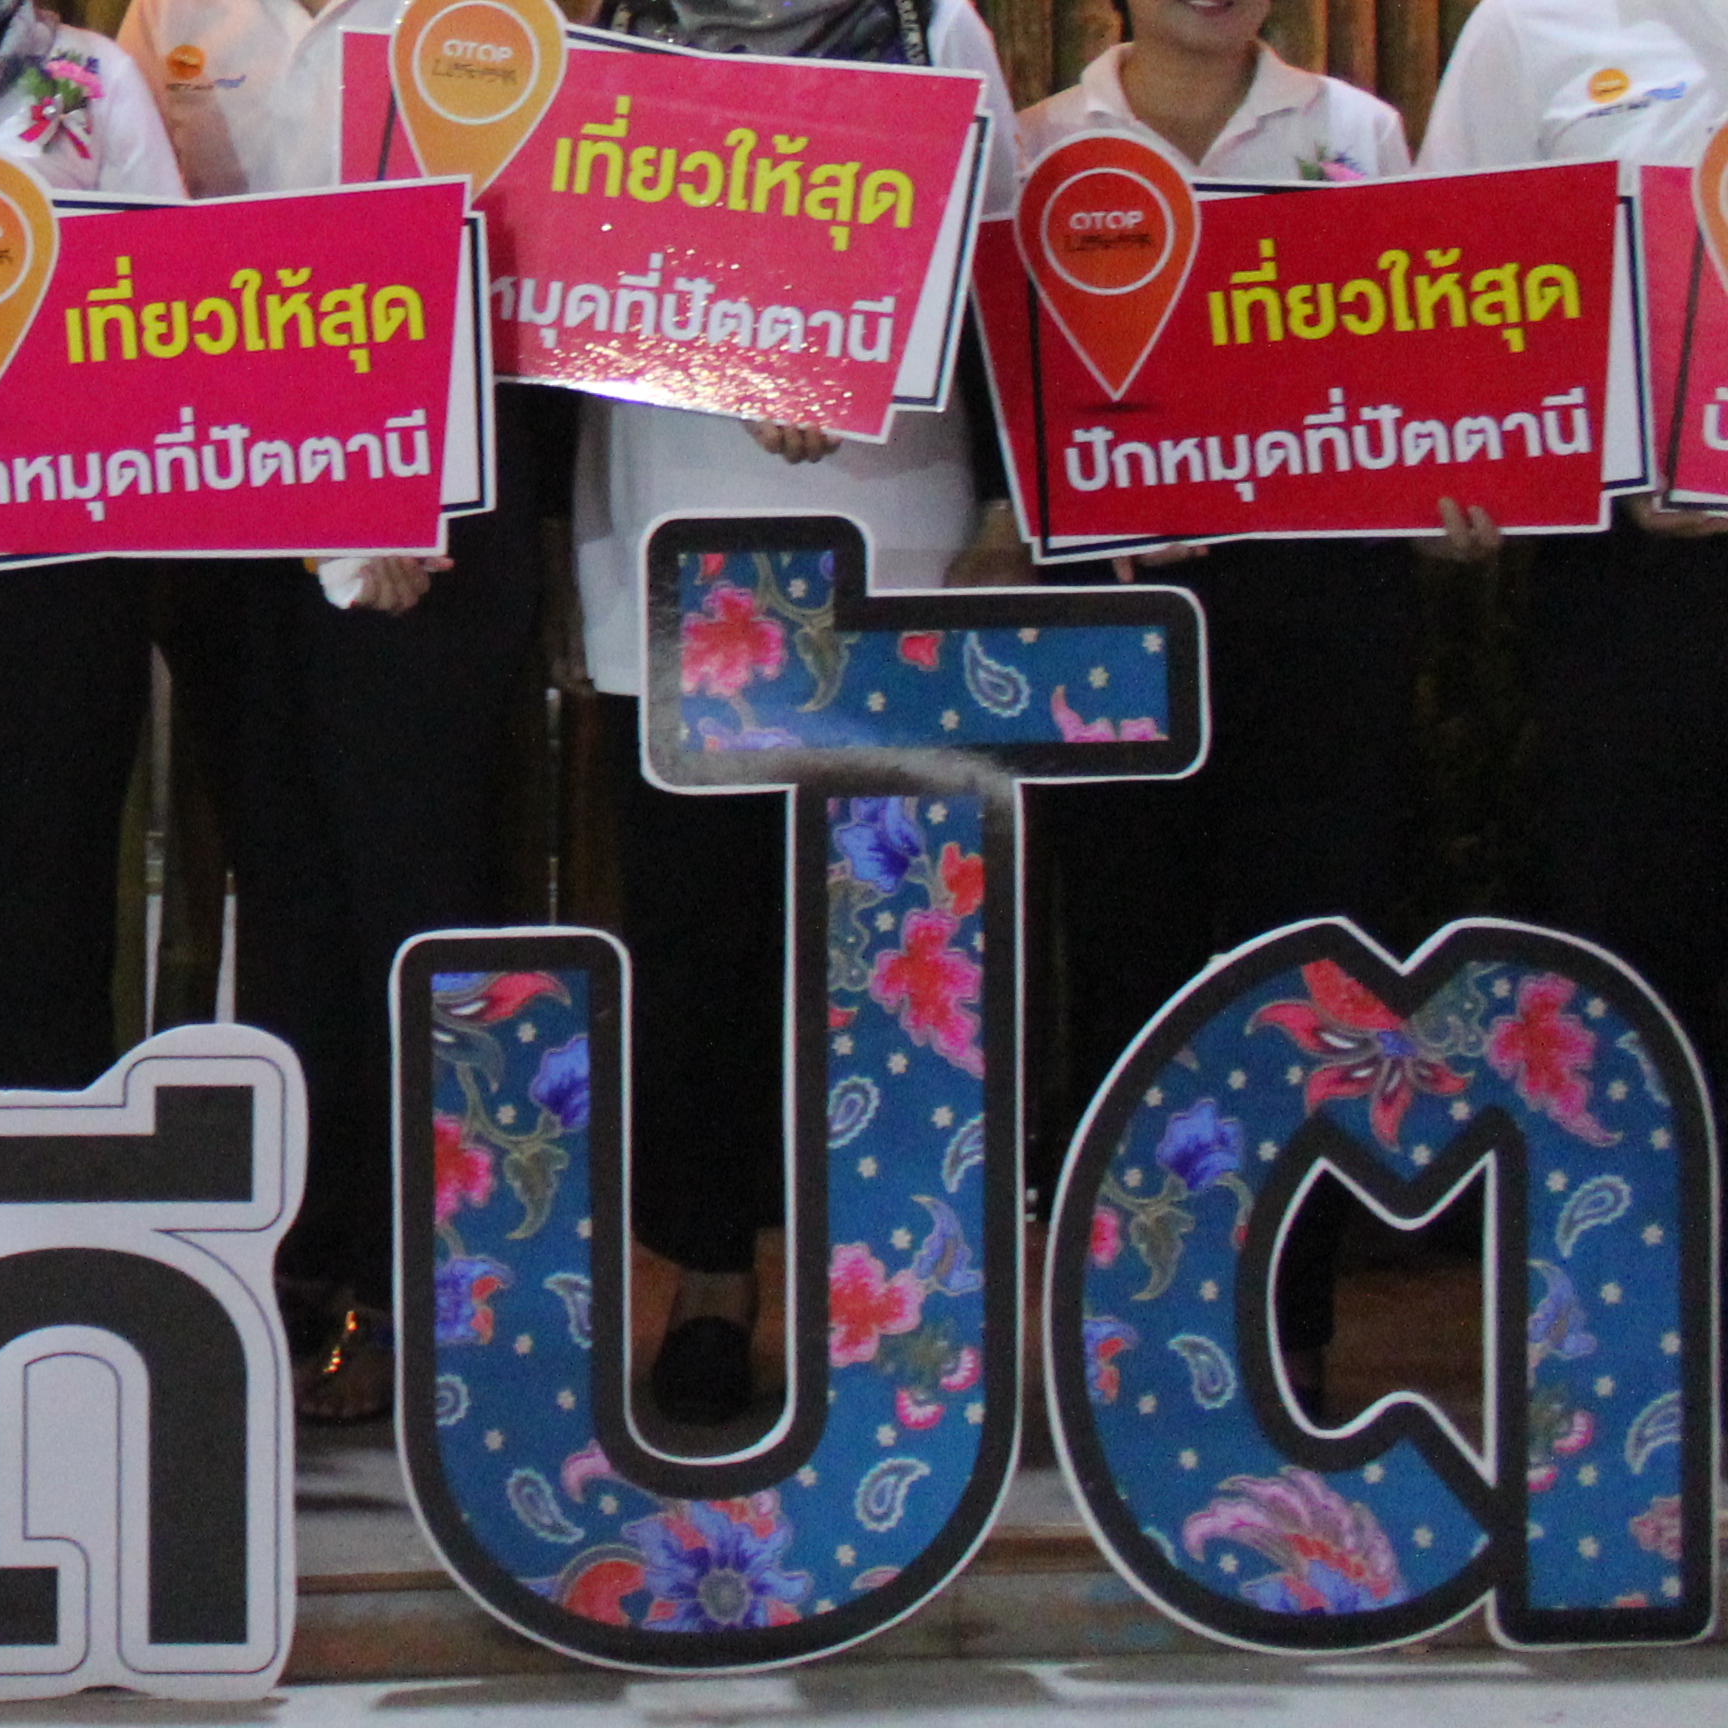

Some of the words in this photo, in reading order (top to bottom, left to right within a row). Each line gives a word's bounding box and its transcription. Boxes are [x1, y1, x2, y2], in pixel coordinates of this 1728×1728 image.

[442, 38, 514, 63] OTOP
[550, 95, 915, 252] เที่ยวให้สุด
[1069, 210, 1145, 232] OTOP
[64, 255, 426, 375] เที่ยวให้สุด
[1207, 238, 1581, 353] เที่ยวให้สุด
[1064, 386, 1593, 503] ปักหมุดที่ปัตตานี
